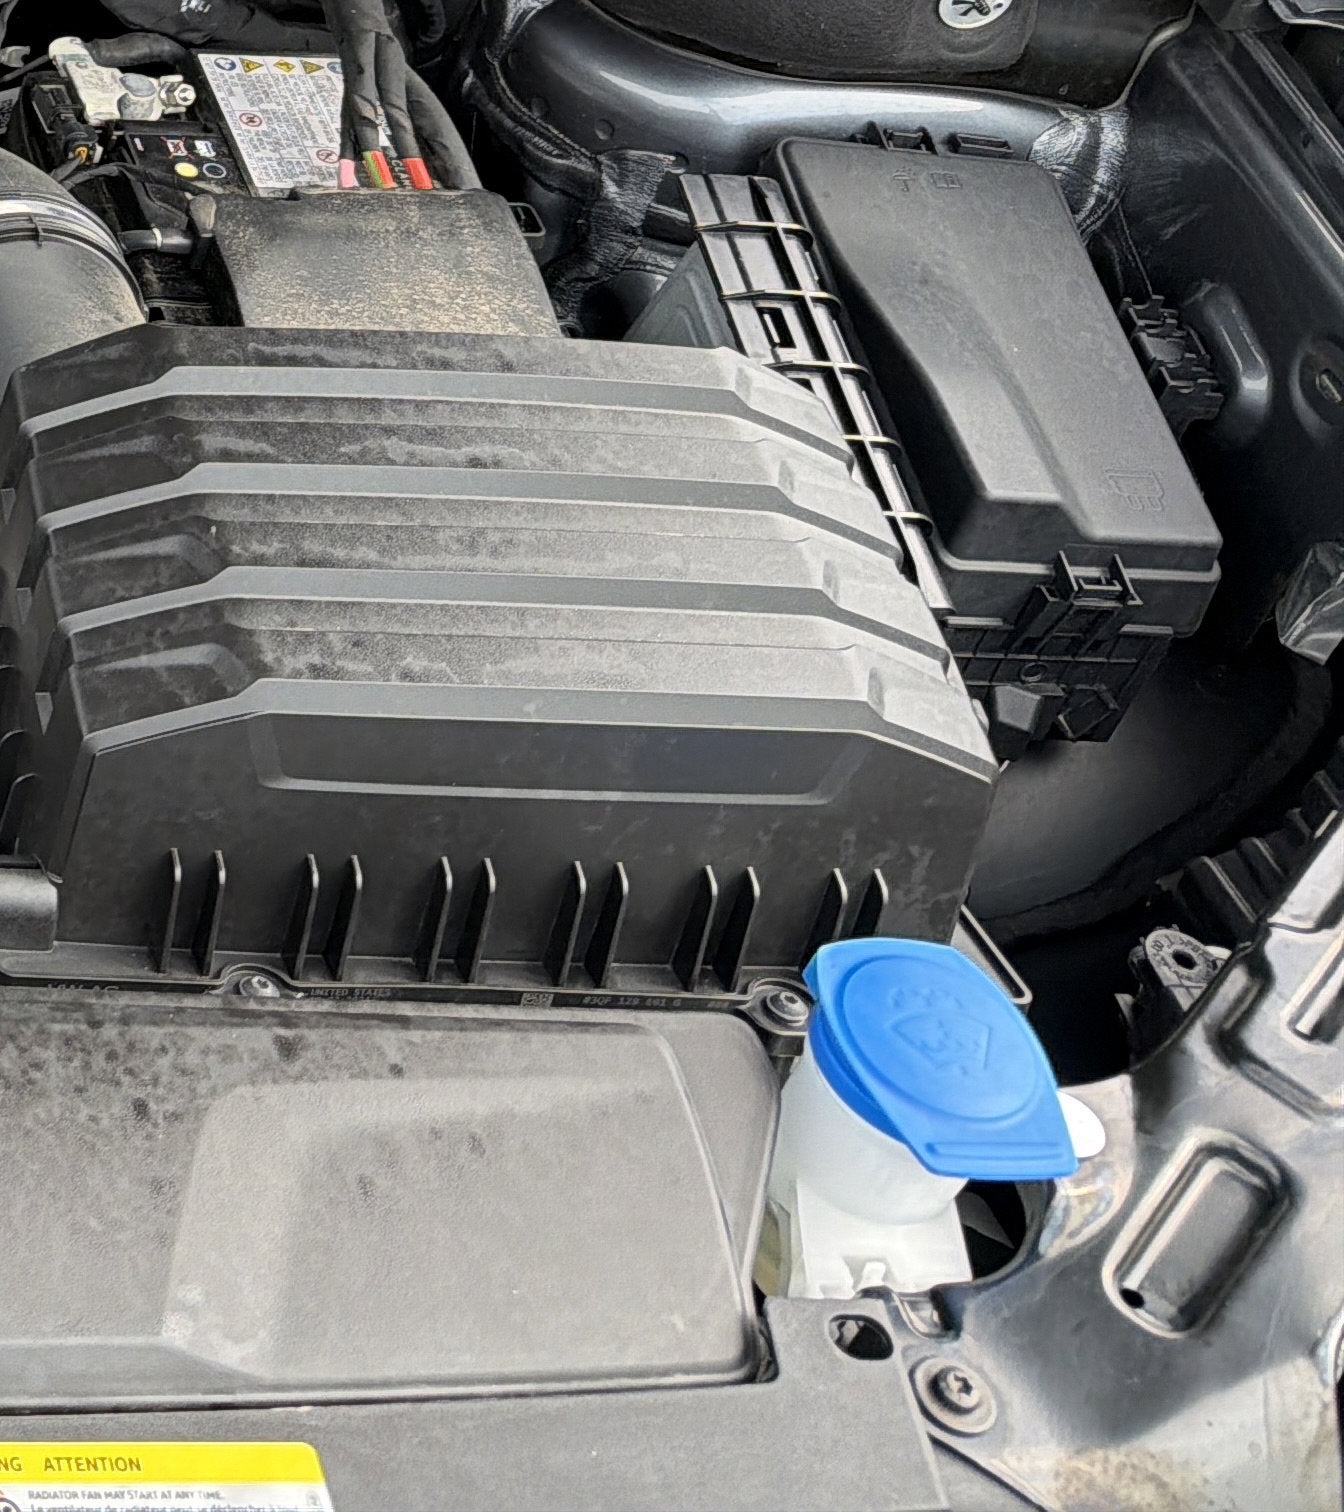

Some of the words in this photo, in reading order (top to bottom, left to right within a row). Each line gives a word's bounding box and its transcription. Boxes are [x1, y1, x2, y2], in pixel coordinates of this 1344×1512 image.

[311, 987, 349, 997] UNITED
[353, 988, 393, 997] STATES
[43, 1455, 143, 1473] ATTENTION
[28, 1489, 79, 1500] RADIATOR
